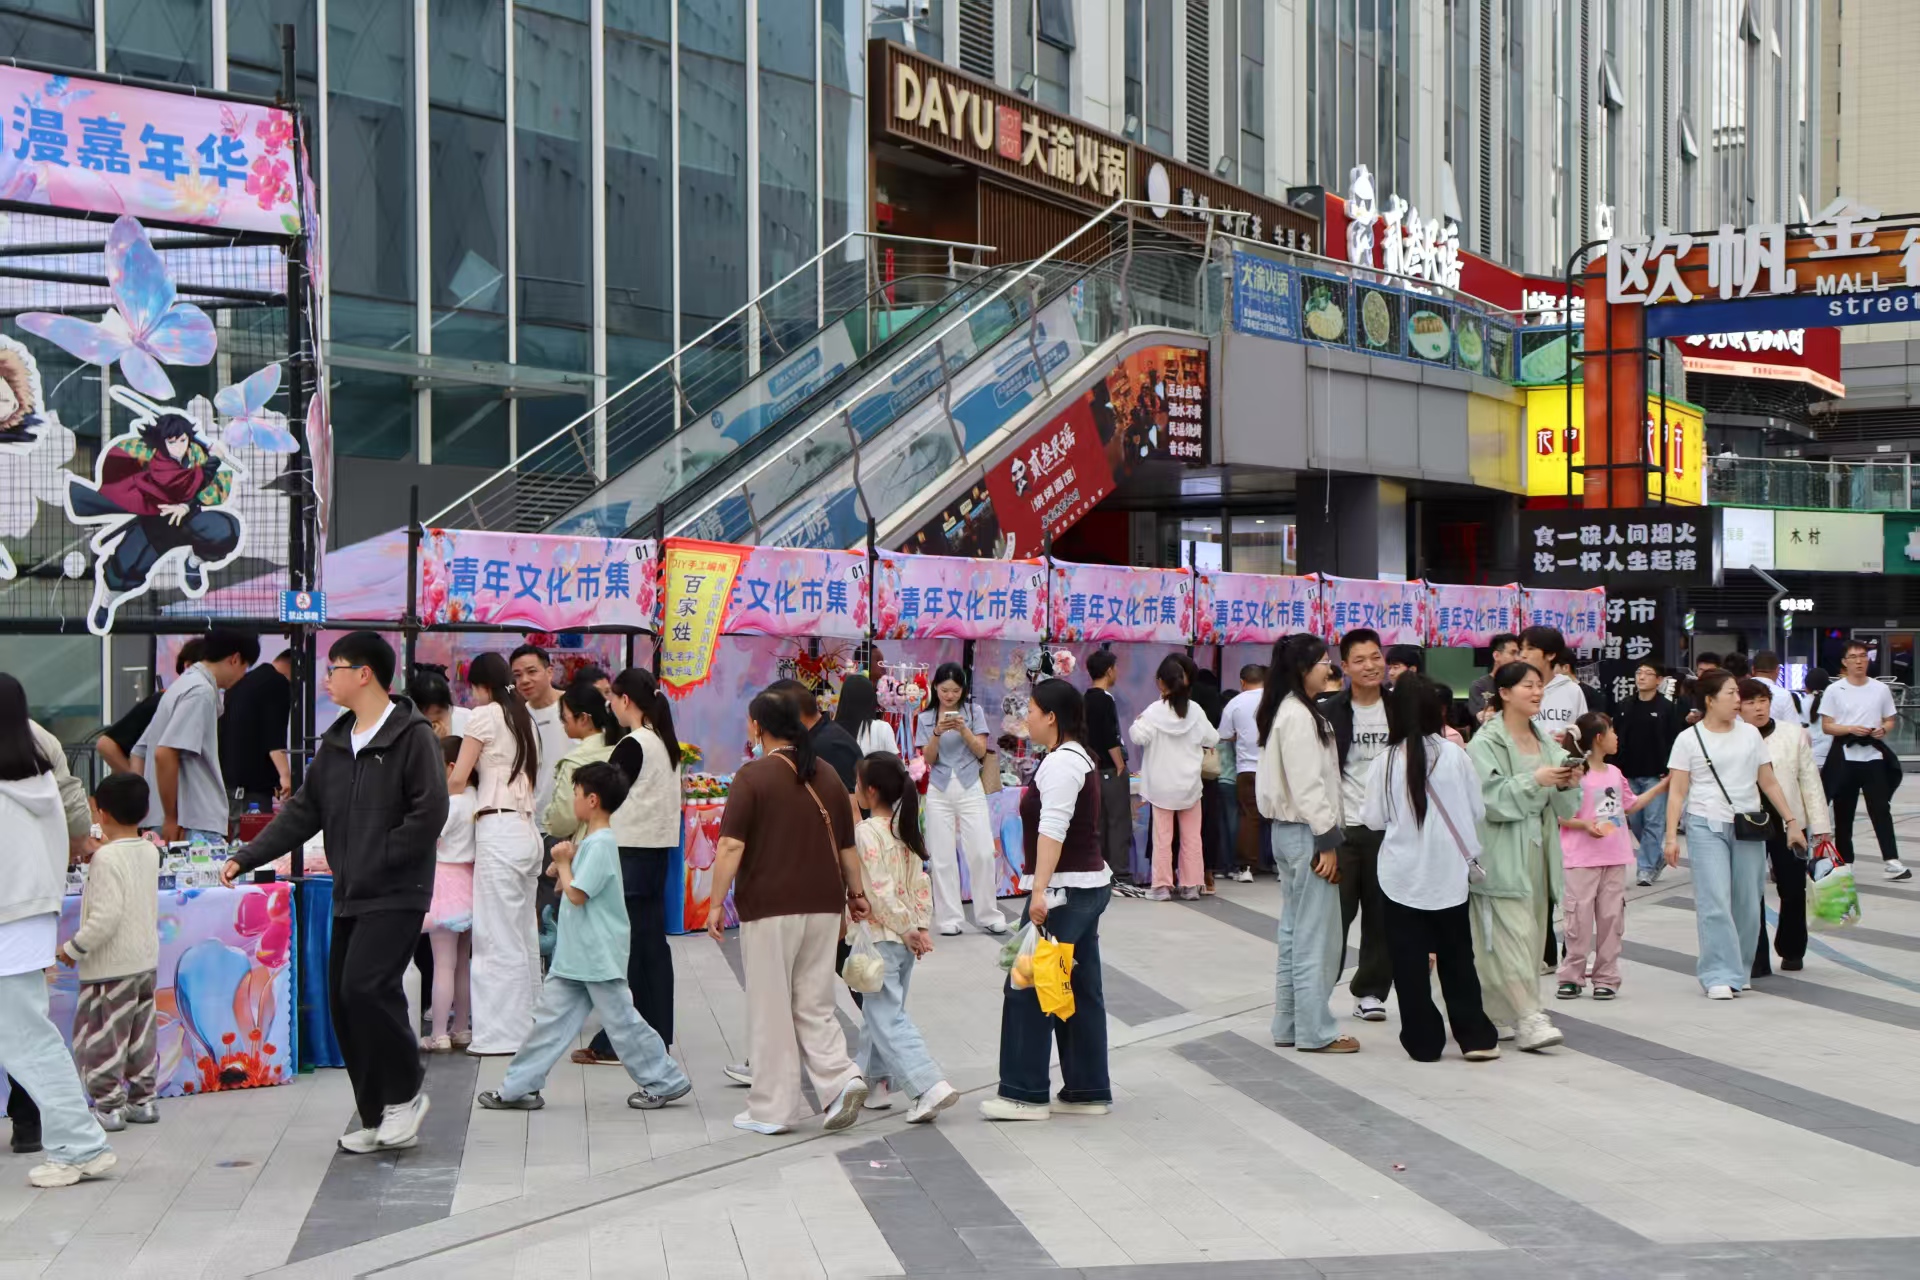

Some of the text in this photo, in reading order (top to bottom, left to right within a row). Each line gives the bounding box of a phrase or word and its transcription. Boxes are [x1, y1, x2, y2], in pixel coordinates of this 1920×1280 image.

[895, 62, 993, 150] DAYU
[0, 104, 249, 188] 漫嘉年华
[1022, 115, 1126, 199] 大渝火锅
[1241, 262, 1289, 297] 大渝火锅
[1816, 271, 1889, 296] MALL
[1828, 291, 1920, 316] street
[1168, 384, 1202, 401] 互动点歌
[1168, 440, 1202, 458] 音乐好听
[1534, 523, 1697, 546] 食一碗人间烟火
[1790, 528, 1822, 545] 木村
[635, 544, 649, 560] 01
[1534, 551, 1697, 573] 饮一杯人生起落
[452, 556, 630, 606] 青年文化市集
[851, 563, 865, 580] 01
[1031, 573, 1044, 588] 01
[1179, 581, 1190, 594] 01
[1307, 588, 1316, 600] 01
[672, 574, 706, 641] 百家姓
[900, 587, 1029, 622] 青年文化市集
[1069, 593, 1177, 626] 青年文化市集
[1214, 600, 1305, 628] 青年文化市集
[1334, 602, 1413, 628] 青年文化市集
[1607, 597, 1657, 623] 好市
[1438, 606, 1508, 633] 青年文化市集
